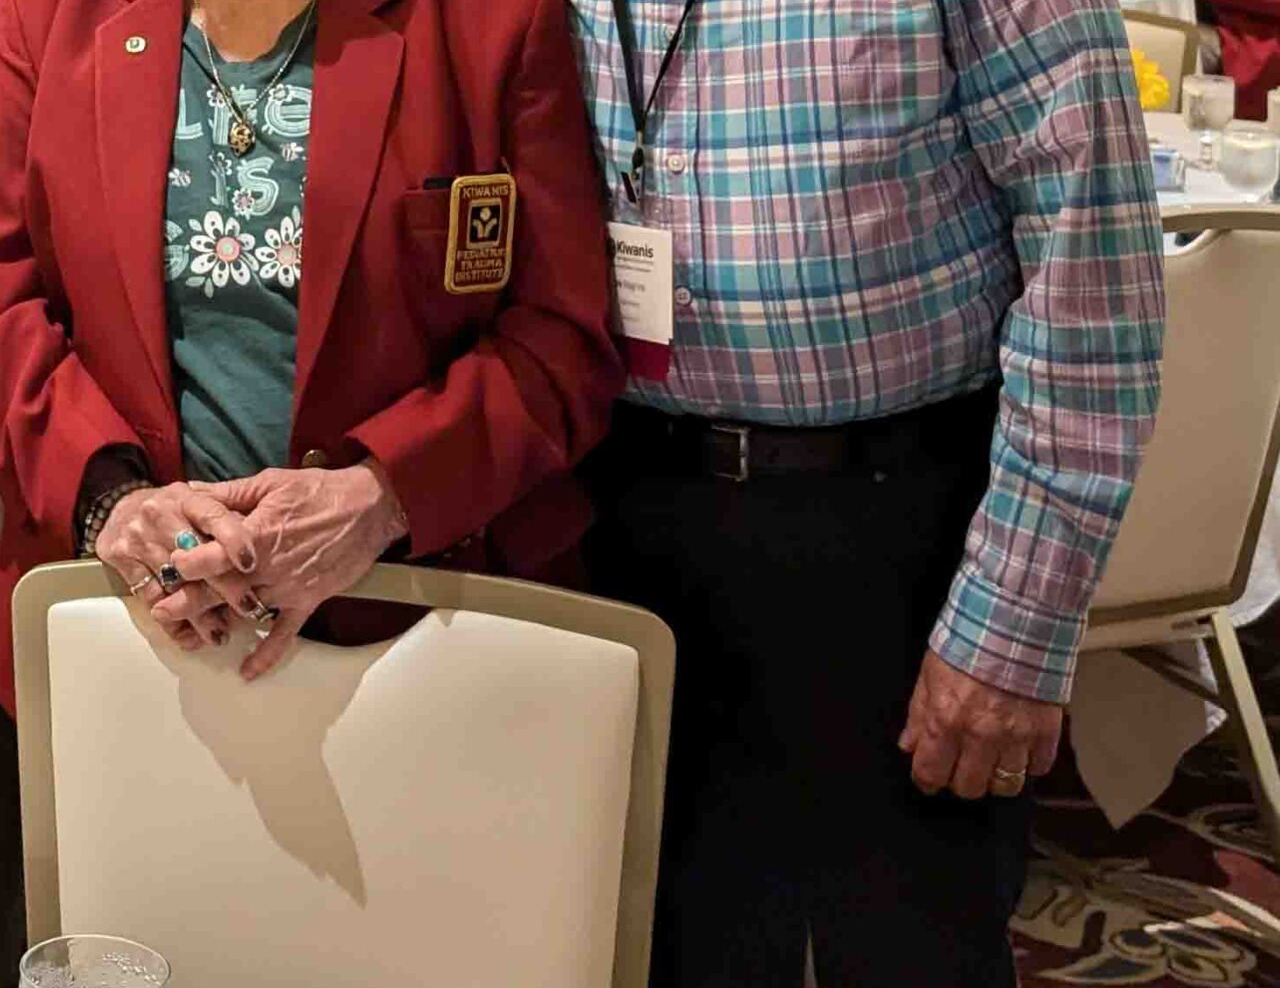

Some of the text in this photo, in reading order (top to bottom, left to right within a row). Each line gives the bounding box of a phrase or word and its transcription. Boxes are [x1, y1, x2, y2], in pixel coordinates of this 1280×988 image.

[462, 185, 509, 199] KIWANIS
[616, 241, 655, 259] Kiwanis
[460, 258, 503, 271] TRAUMA
